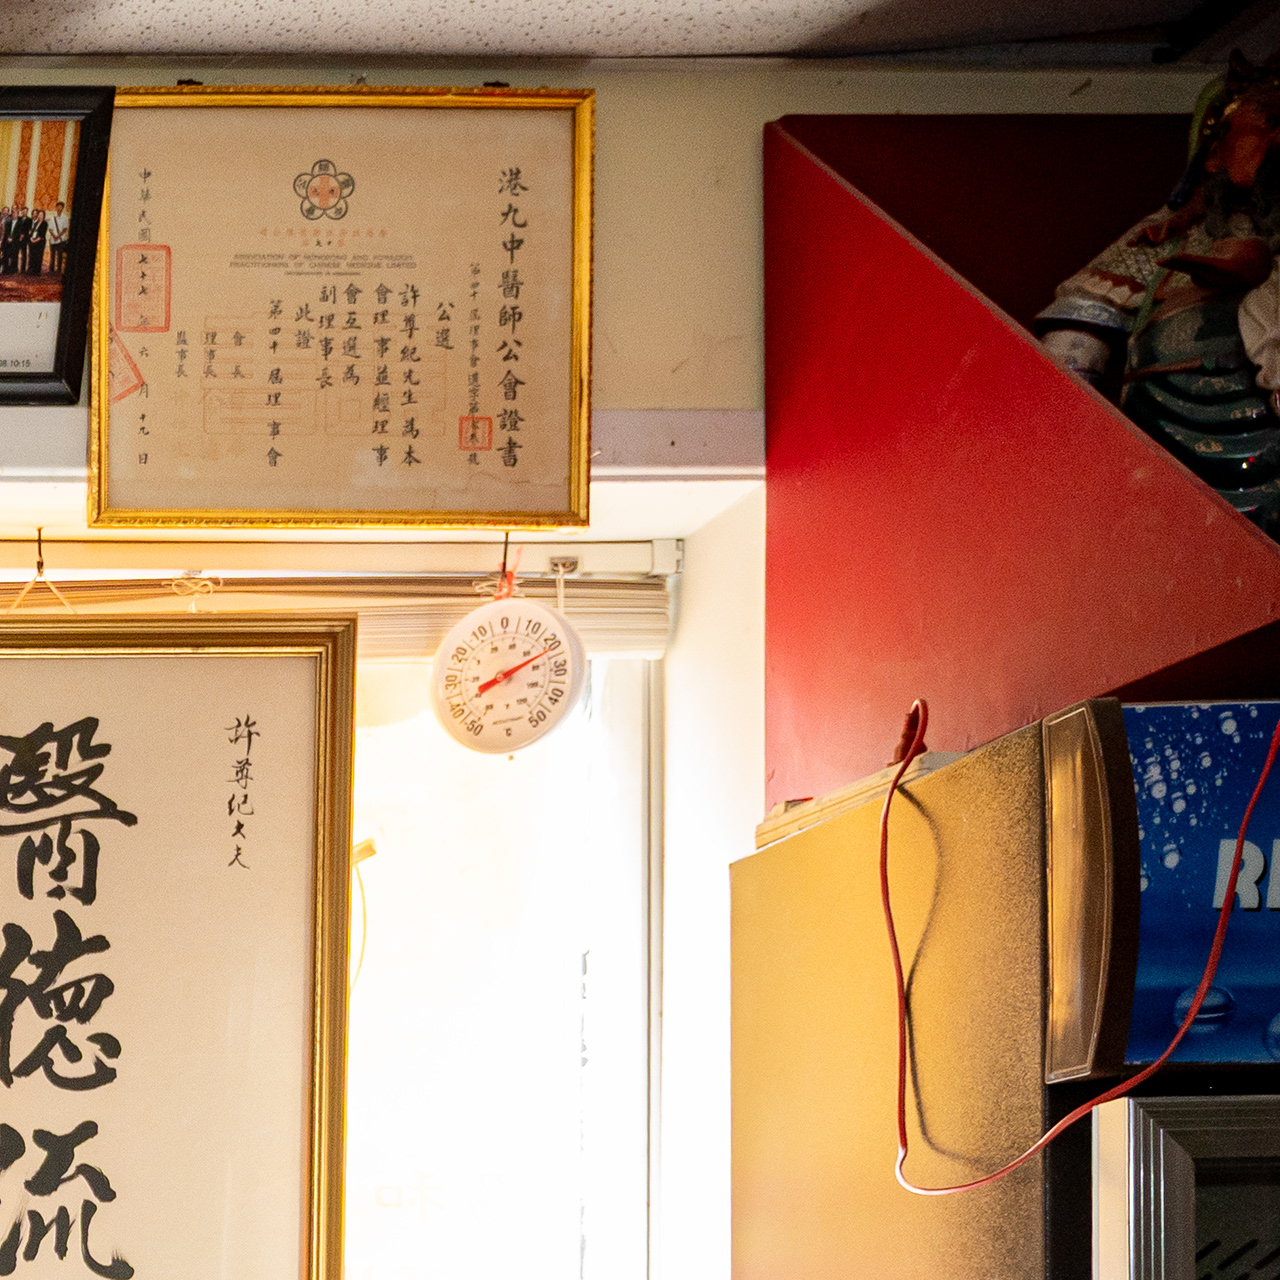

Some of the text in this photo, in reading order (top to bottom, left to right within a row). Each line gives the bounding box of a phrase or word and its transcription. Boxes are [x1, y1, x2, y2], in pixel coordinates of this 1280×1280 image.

[294, 303, 315, 350] 此證
[496, 167, 530, 468] 港九中醫師公會證書
[501, 617, 509, 629] 0
[525, 619, 541, 635] 10
[544, 633, 561, 651] 20
[554, 659, 567, 677] 30
[548, 687, 564, 705] 40
[528, 710, 546, 728] 50
[1212, 838, 1280, 909] R
